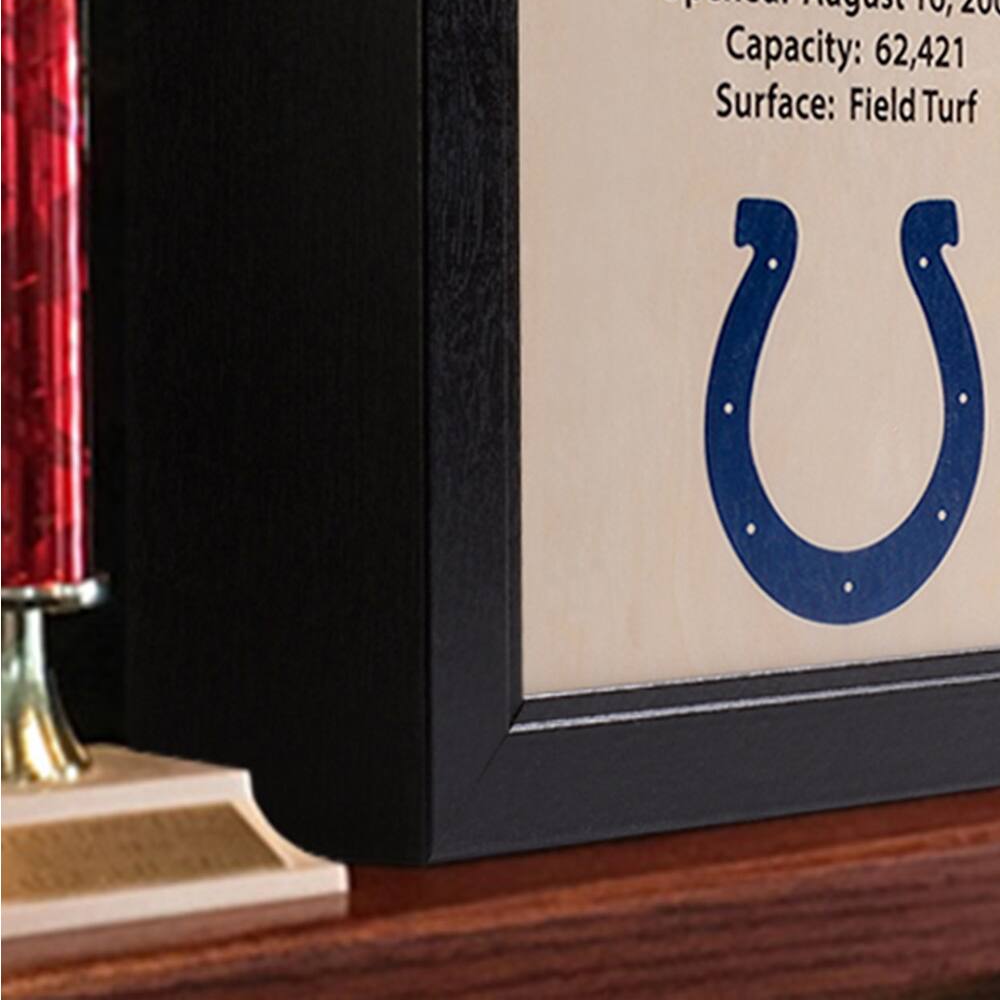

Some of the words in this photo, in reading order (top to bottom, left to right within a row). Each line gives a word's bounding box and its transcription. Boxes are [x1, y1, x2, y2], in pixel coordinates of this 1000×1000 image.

[726, 24, 860, 73] Capacity:
[875, 33, 963, 71] 62,421
[716, 82, 834, 120] Surface:
[850, 86, 915, 122] Field
[922, 89, 978, 124] Turf
